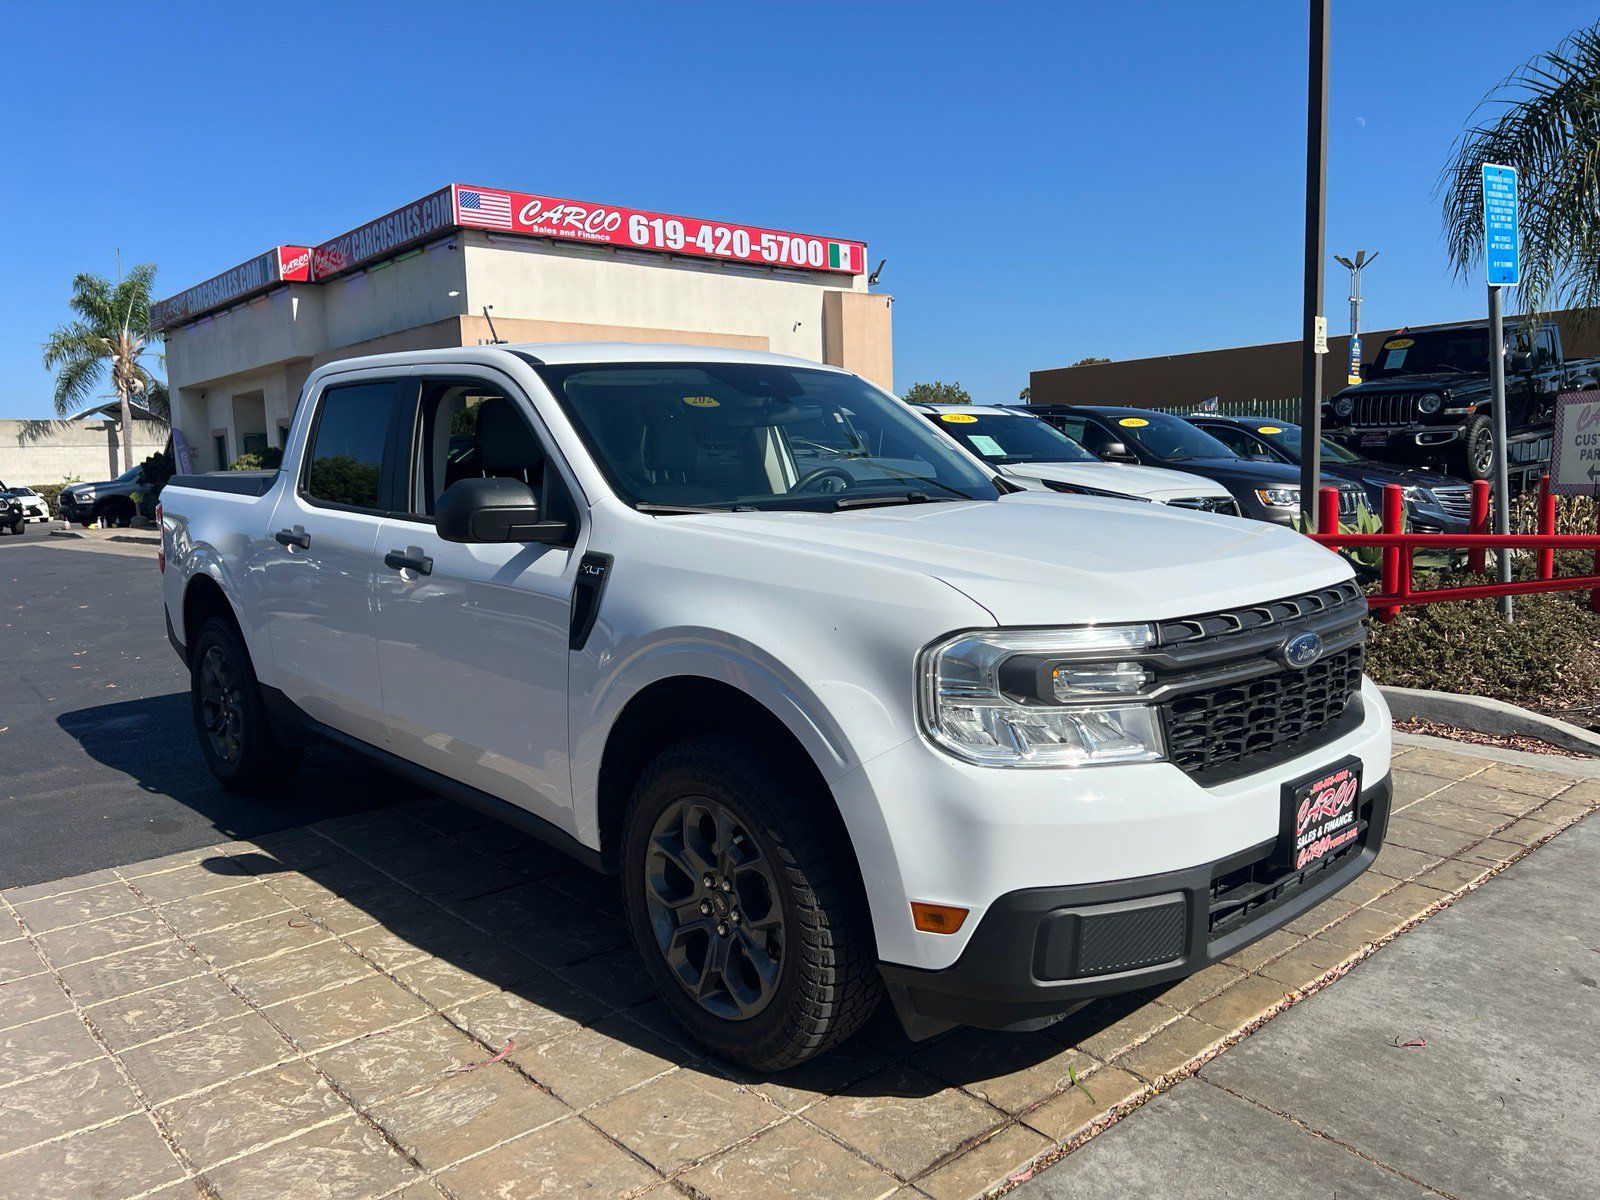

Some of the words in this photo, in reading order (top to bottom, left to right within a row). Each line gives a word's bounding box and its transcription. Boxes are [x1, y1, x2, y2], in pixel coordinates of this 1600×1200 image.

[350, 190, 453, 262] CARCOSALES.COM
[518, 199, 622, 233] CARCO
[628, 213, 824, 267] 619-420-5700
[532, 224, 557, 235] Sales
[559, 229, 576, 237] and
[577, 230, 611, 241] Finance
[281, 253, 309, 275] CARCO
[186, 259, 263, 315] CARCOSALES.COM
[1574, 432, 1600, 448] CUS
[580, 564, 605, 575] XLT
[1296, 777, 1357, 837] CARCO
[1296, 827, 1317, 850] SALES
[1317, 825, 1323, 839] &
[1323, 811, 1354, 835] FINANCE
